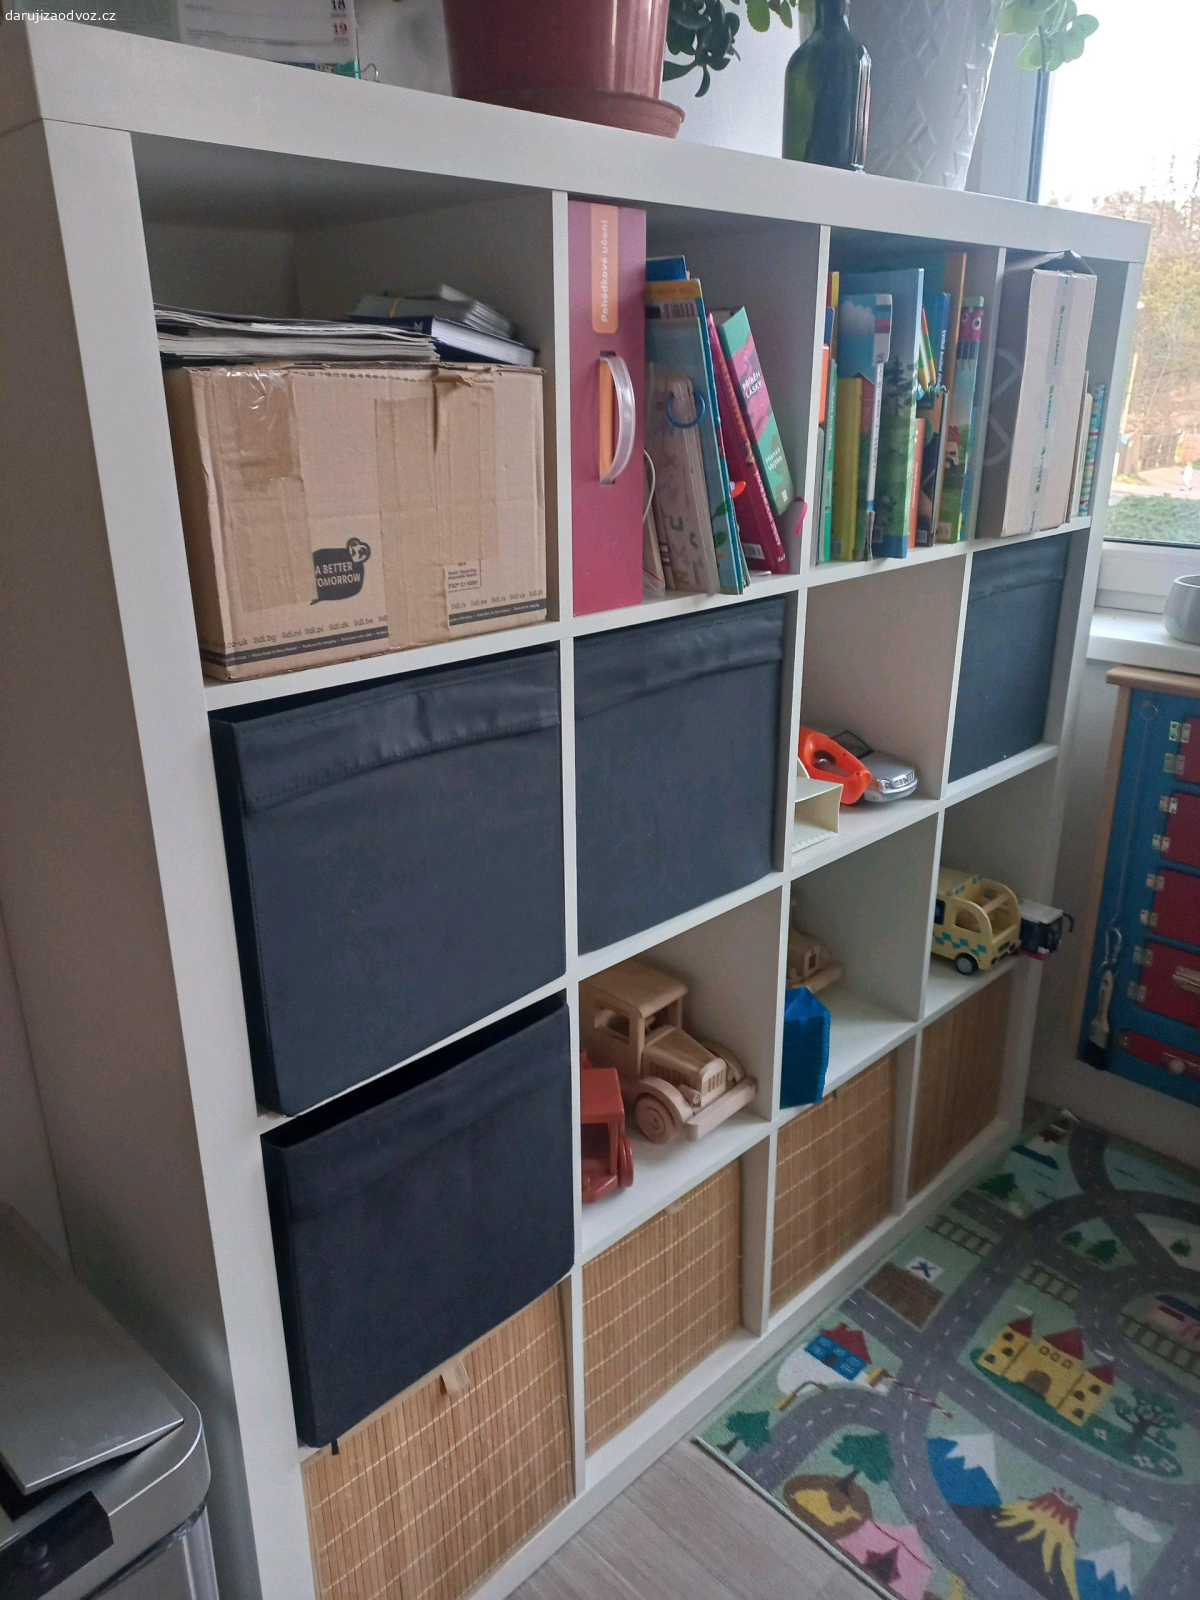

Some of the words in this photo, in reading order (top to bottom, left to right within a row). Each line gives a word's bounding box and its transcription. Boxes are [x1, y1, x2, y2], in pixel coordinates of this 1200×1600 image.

[333, 22, 348, 36] 19
[315, 565, 322, 575] A
[322, 561, 353, 574] BETTER
[315, 573, 361, 588] OMORROW
[253, 634, 277, 644] lidl.bg
[353, 617, 374, 627] lidl.be
